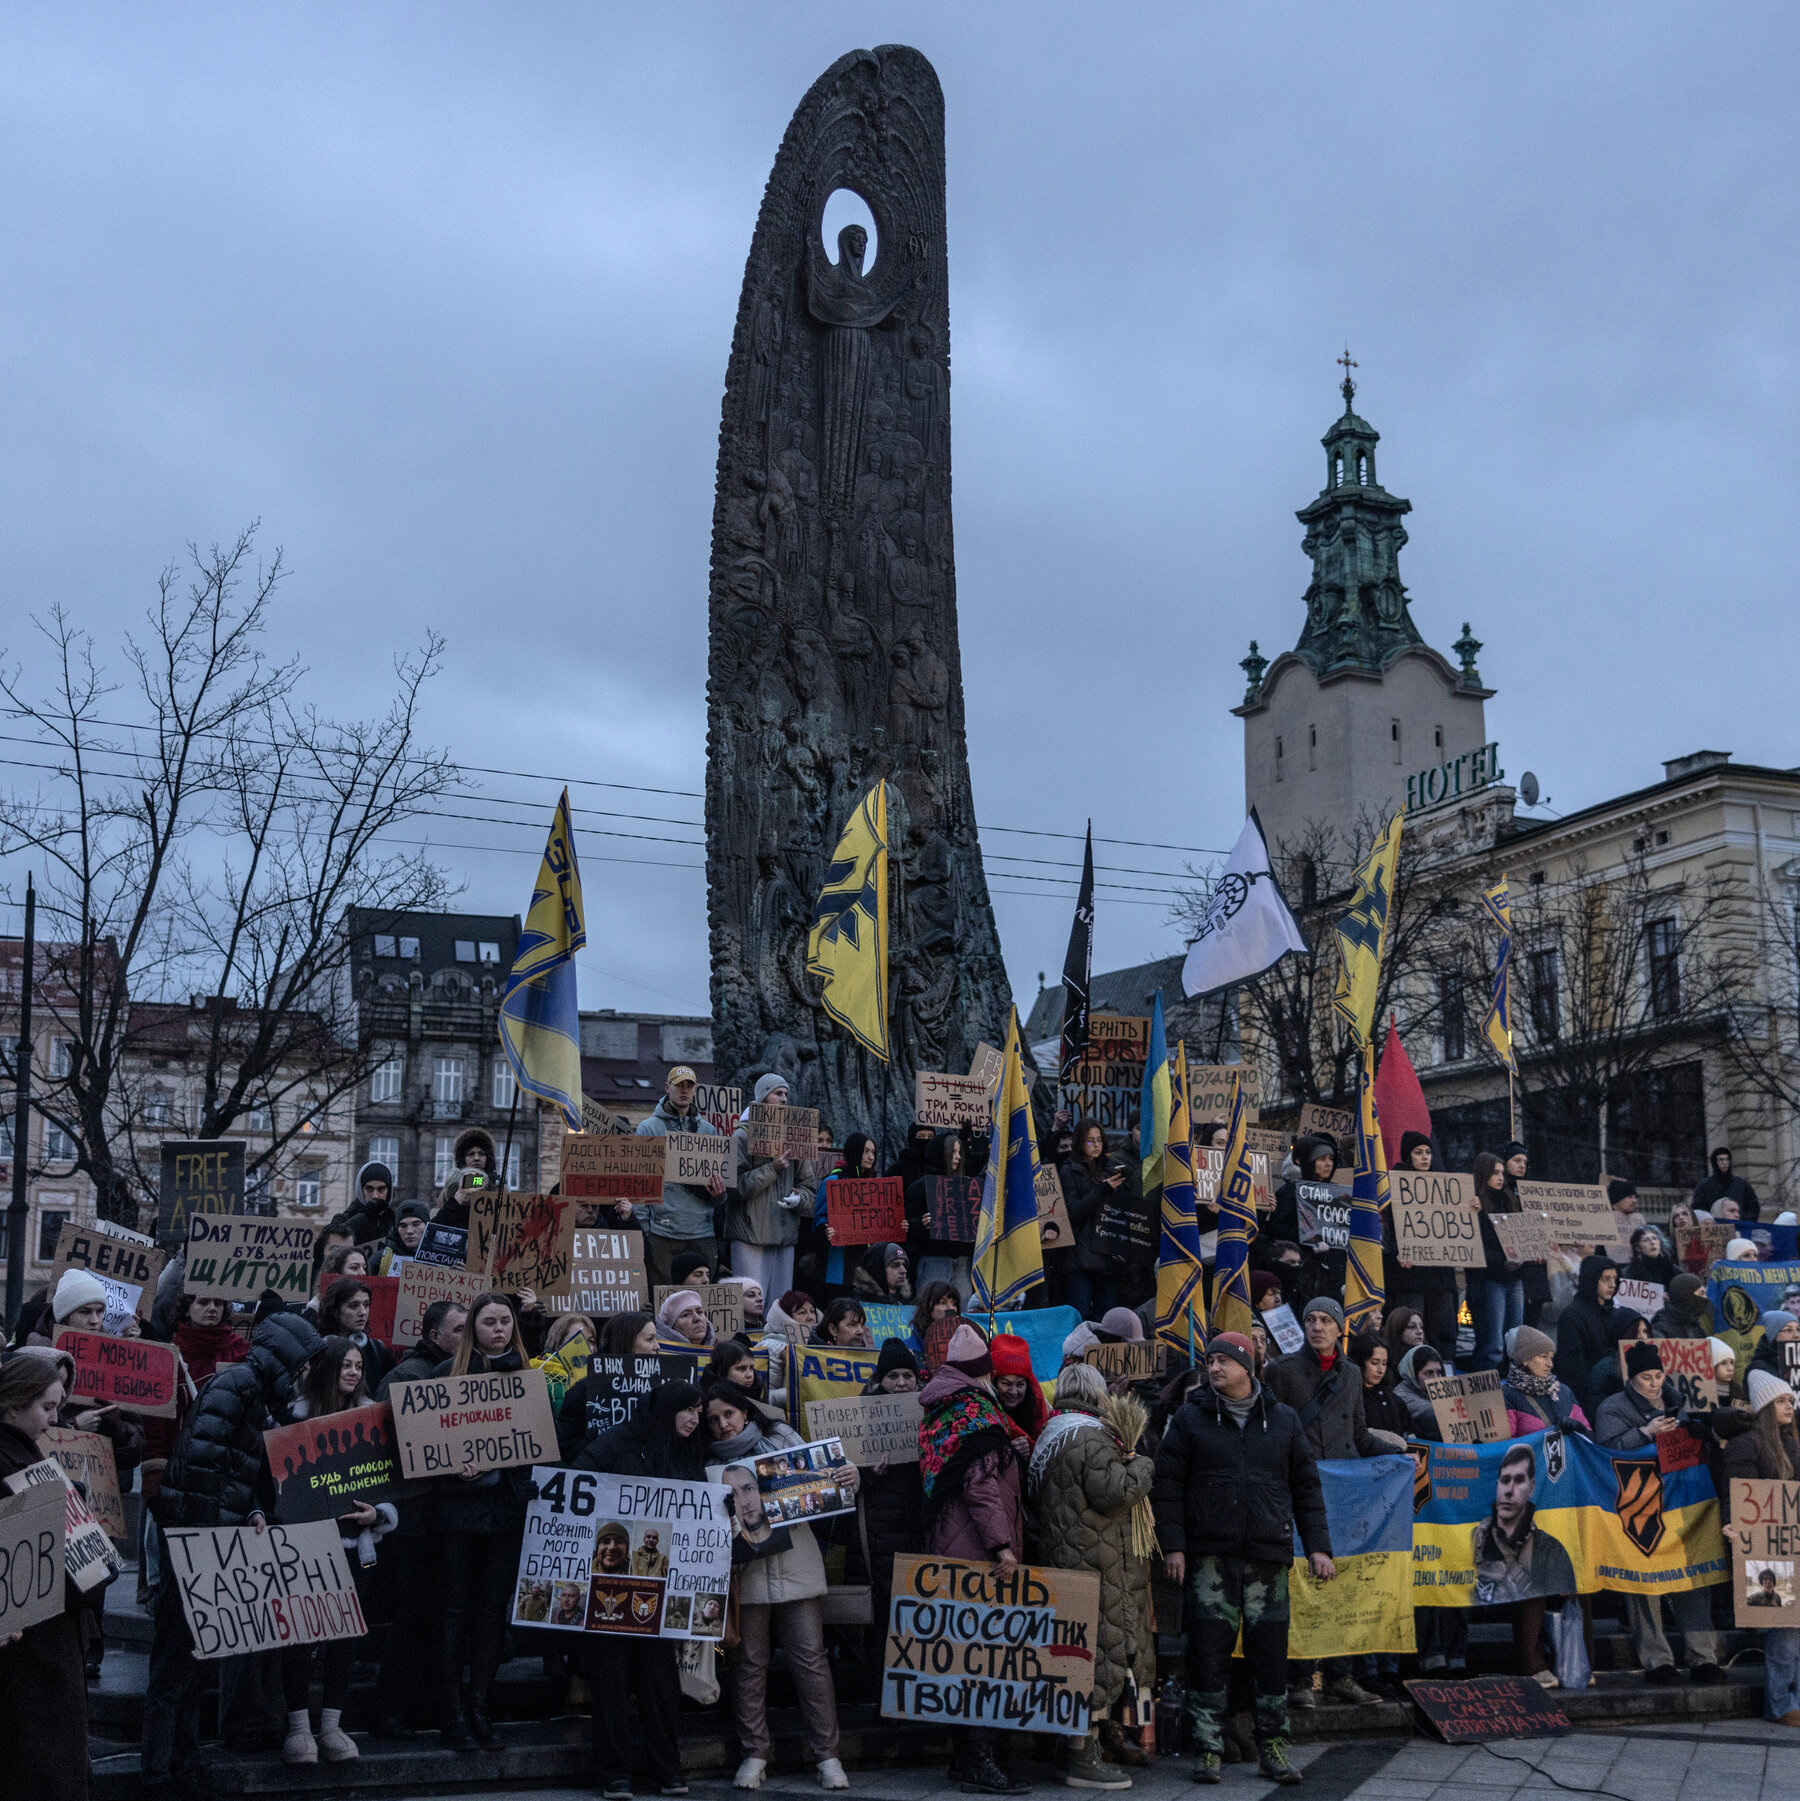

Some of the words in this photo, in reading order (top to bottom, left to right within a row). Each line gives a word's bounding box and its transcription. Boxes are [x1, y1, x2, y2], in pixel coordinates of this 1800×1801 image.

[1404, 742, 1504, 814] HOTEL
[1087, 1021, 1138, 1038] ЕРНІТЬ
[1080, 1039, 1136, 1062] ЗОВ
[1070, 1066, 1144, 1088] ДОДОМУ
[925, 1099, 948, 1111] ТРИ
[954, 1101, 984, 1113] РОКИ
[918, 1110, 965, 1126] СКІЛЬКИ
[669, 1134, 731, 1154] МОВЧАННЯ
[786, 1126, 812, 1143] ВОНИ
[568, 1143, 615, 1157] ДОСИТЬ
[174, 1151, 230, 1191] FREE
[571, 1160, 596, 1171] НАД
[604, 1161, 657, 1174] НАШИМИ
[679, 1157, 730, 1180] ВБИВАЄ
[830, 1182, 903, 1208] ПОВЕРНІТЬ
[1299, 1184, 1333, 1203] СТАНЬ
[1399, 1176, 1461, 1206] ВОЛЮ
[1523, 1201, 1543, 1210] АЗОВ
[510, 1223, 525, 1239] is
[851, 1209, 897, 1230] ГЕРОЇВ
[1403, 1211, 1475, 1240] АЗОВУ
[66, 1237, 150, 1283] ДЕНЬ
[233, 1246, 264, 1259] БУВ
[290, 1249, 312, 1260] НАС
[188, 1258, 308, 1292] ЩИТОМ
[405, 1265, 485, 1291] БАЙДУЖІСТ
[551, 1290, 640, 1312] ПОЛОНЕНИМ
[708, 1287, 738, 1307] ДЕНЬ
[65, 1336, 89, 1360] НЕ
[98, 1340, 148, 1372] МОВЧИ
[634, 1357, 661, 1378] ОДНА
[114, 1374, 164, 1400] ВБИВАЄ
[401, 1383, 451, 1415] АЗОВ
[458, 1376, 526, 1405] ЗРОБИВ
[612, 1377, 652, 1394] ЄДИНА
[440, 1407, 512, 1428] НЕМОЖЛИВЕ
[423, 1443, 453, 1471] ВИ
[462, 1428, 542, 1464] ЗРОБІТЬ
[860, 1436, 918, 1456] ДОДОМУ
[310, 1471, 342, 1489] БУДЬ
[349, 1458, 394, 1477] ГОЛОСОМ
[329, 1472, 391, 1496] ПОЛОНЕНИХ
[540, 1471, 598, 1516] 46
[618, 1484, 713, 1521] БРИГАДА
[1739, 1482, 1778, 1525] 31
[166, 1529, 249, 1574] ТИ
[268, 1526, 300, 1565] В
[1739, 1530, 1753, 1555] У
[526, 1554, 592, 1580] БРАТА!
[192, 1602, 277, 1656] ВОНИ
[271, 1598, 290, 1640] В
[288, 1586, 367, 1640] ПОЛОНІ
[895, 1600, 1050, 1648] ГОЛОСОМ
[1050, 1618, 1087, 1649] ТИХ
[890, 1636, 954, 1674] ХТО
[963, 1642, 1042, 1682] СТАВ
[887, 1673, 1002, 1719] ТВОЇМ
[1003, 1675, 1094, 1729] ЩИТОМ
[1414, 1685, 1483, 1703] ПОЛОН
[1448, 1699, 1526, 1718] СМЕРТЬ
